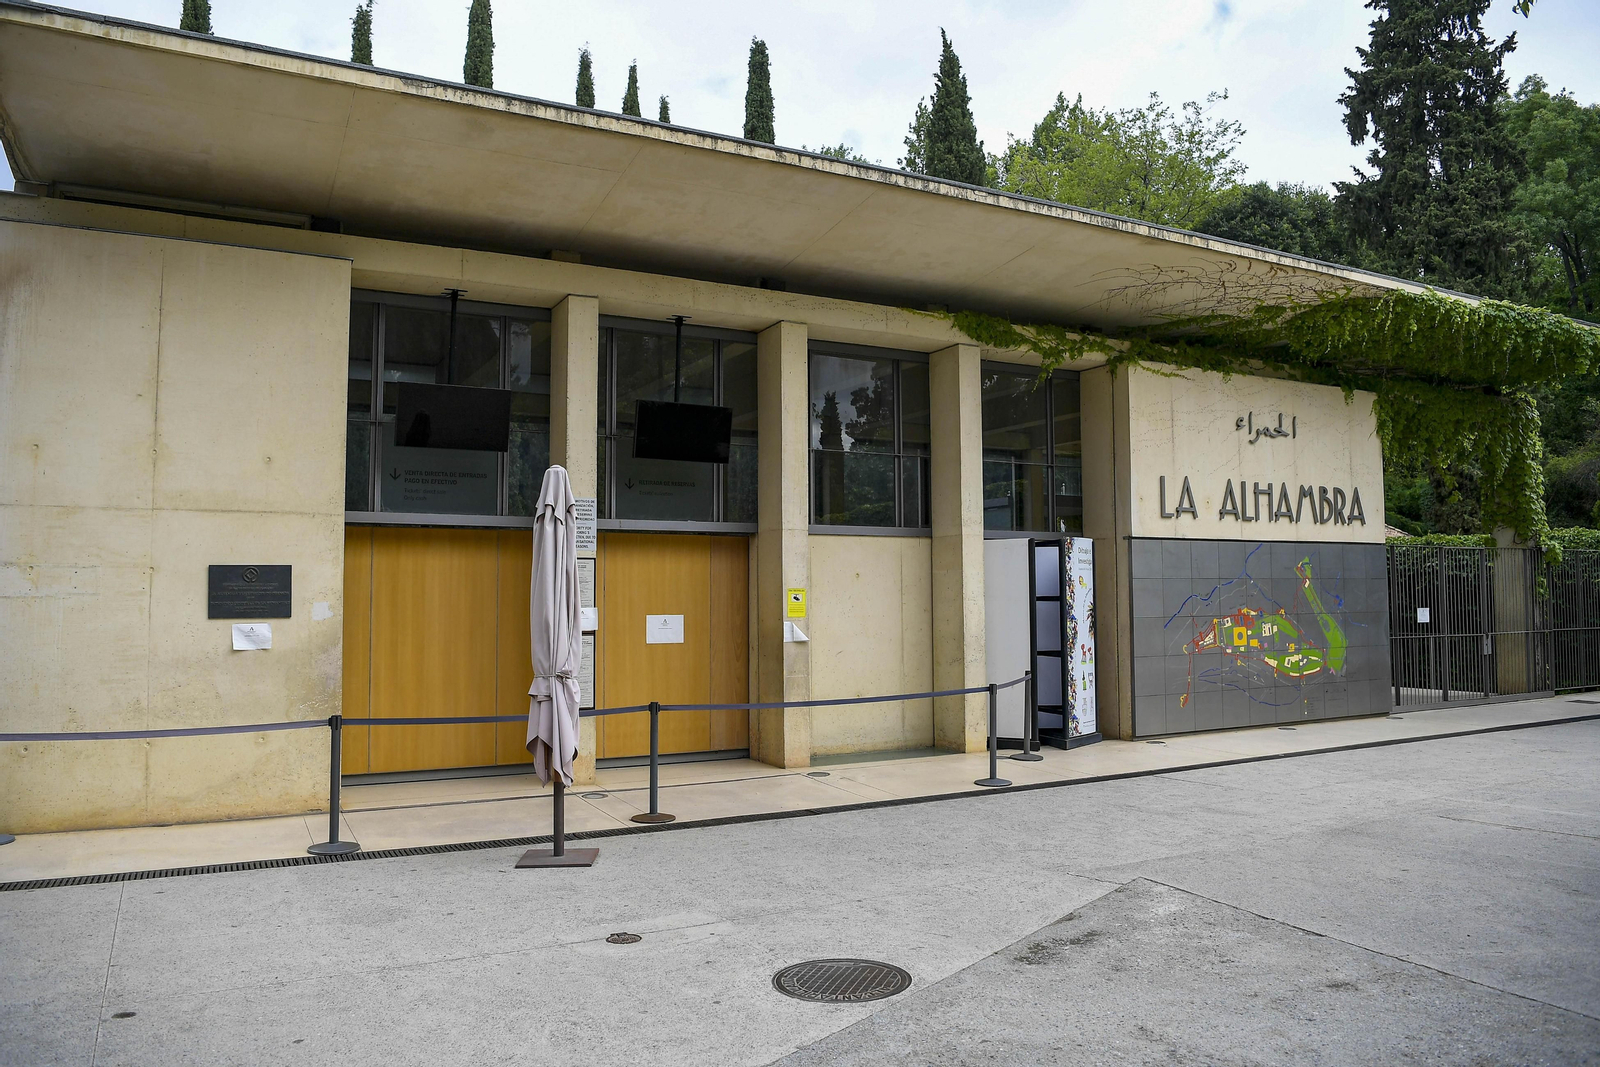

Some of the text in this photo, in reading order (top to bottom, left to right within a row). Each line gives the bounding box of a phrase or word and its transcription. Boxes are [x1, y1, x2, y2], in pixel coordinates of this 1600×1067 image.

[1236, 411, 1296, 444] الحمراء
[1160, 476, 1366, 526] LA ALHAMBRA
